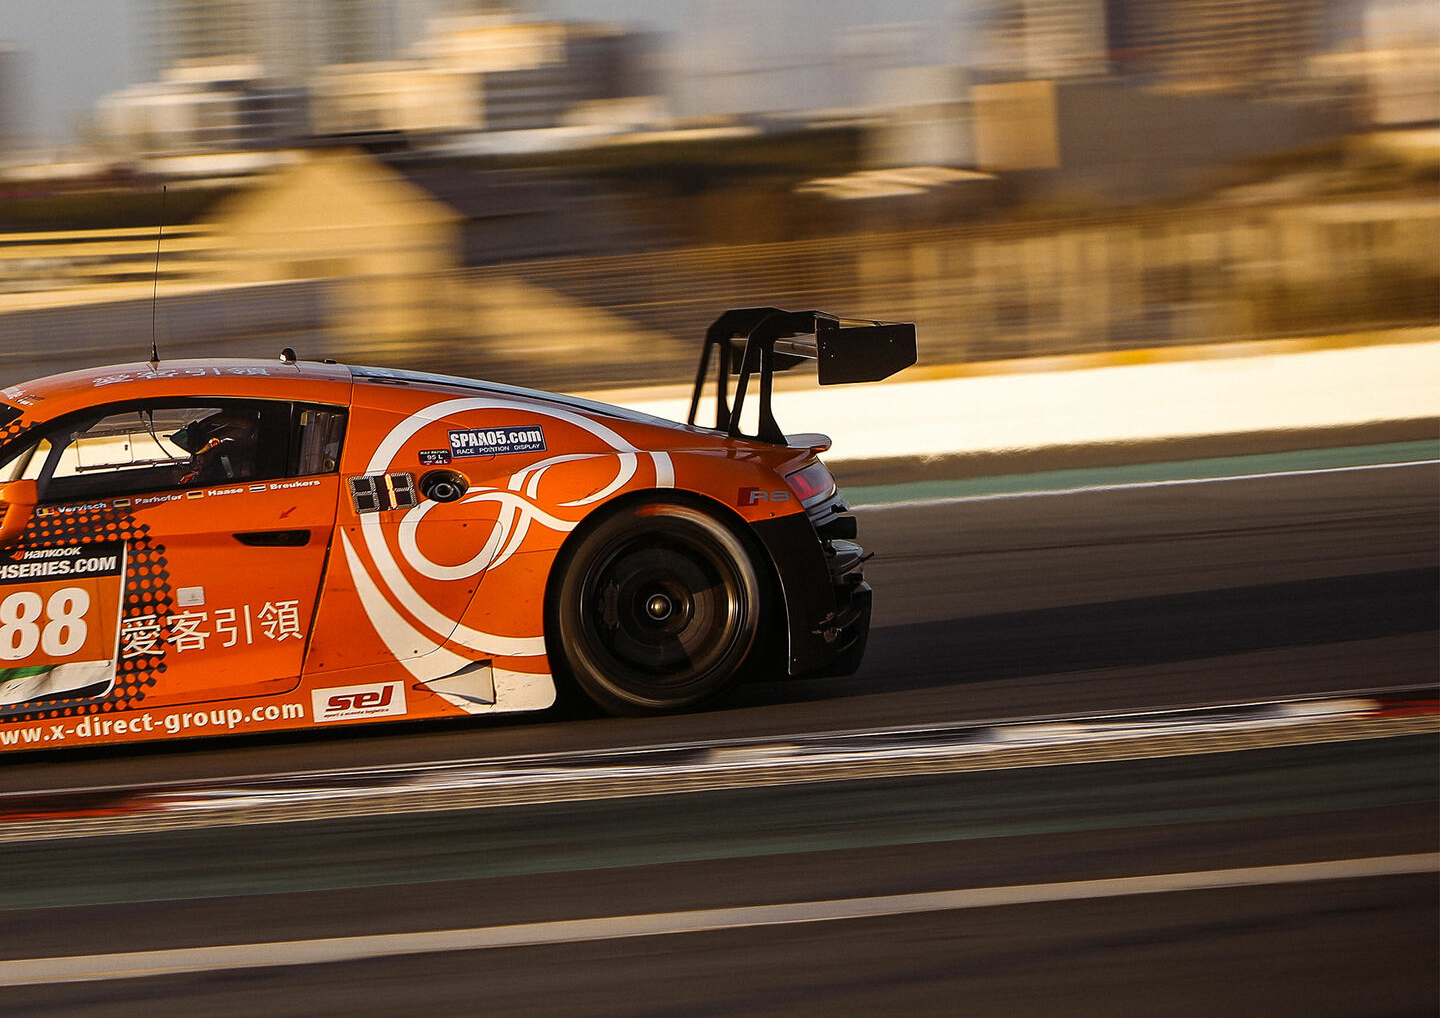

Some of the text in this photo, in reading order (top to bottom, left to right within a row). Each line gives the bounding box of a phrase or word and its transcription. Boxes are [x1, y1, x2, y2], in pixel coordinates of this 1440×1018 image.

[456, 447, 474, 455] RACE
[514, 443, 540, 451] DISPLAY
[57, 501, 107, 514] Vervisch
[208, 487, 245, 497] Haase
[270, 480, 321, 490] Breukers
[749, 490, 791, 504] R8
[121, 599, 304, 660] 愛客引領
[325, 685, 394, 712] sel
